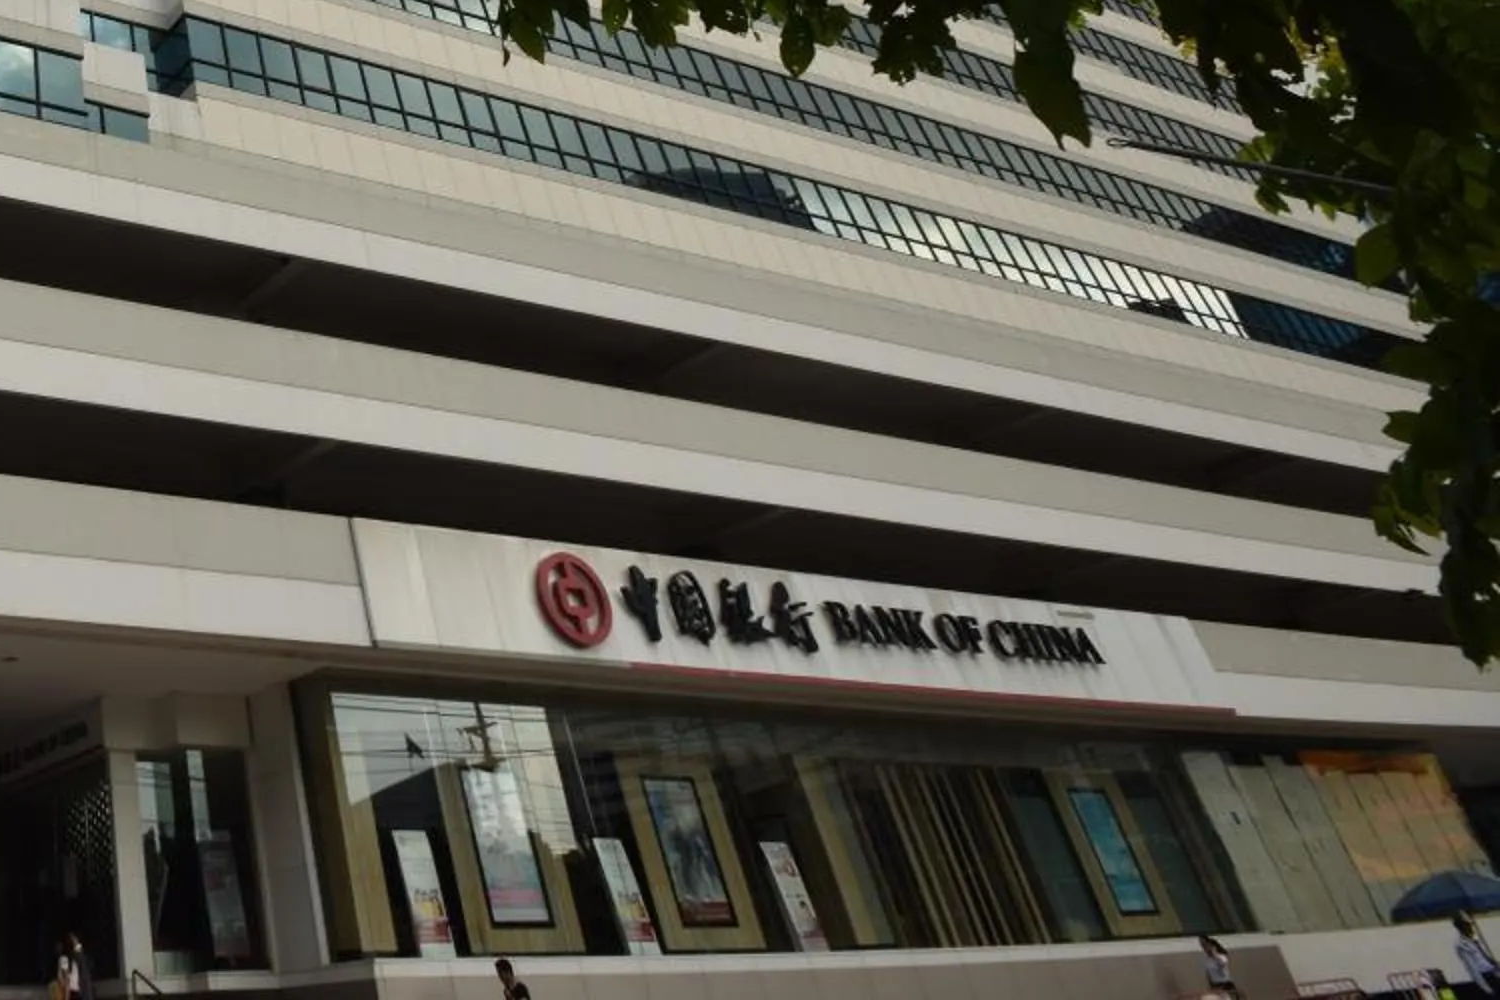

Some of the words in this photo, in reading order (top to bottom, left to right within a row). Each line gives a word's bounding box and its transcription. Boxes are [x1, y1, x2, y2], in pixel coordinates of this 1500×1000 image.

[821, 600, 938, 652] BANK
[933, 613, 984, 654] OF
[987, 619, 1107, 665] CHINA
